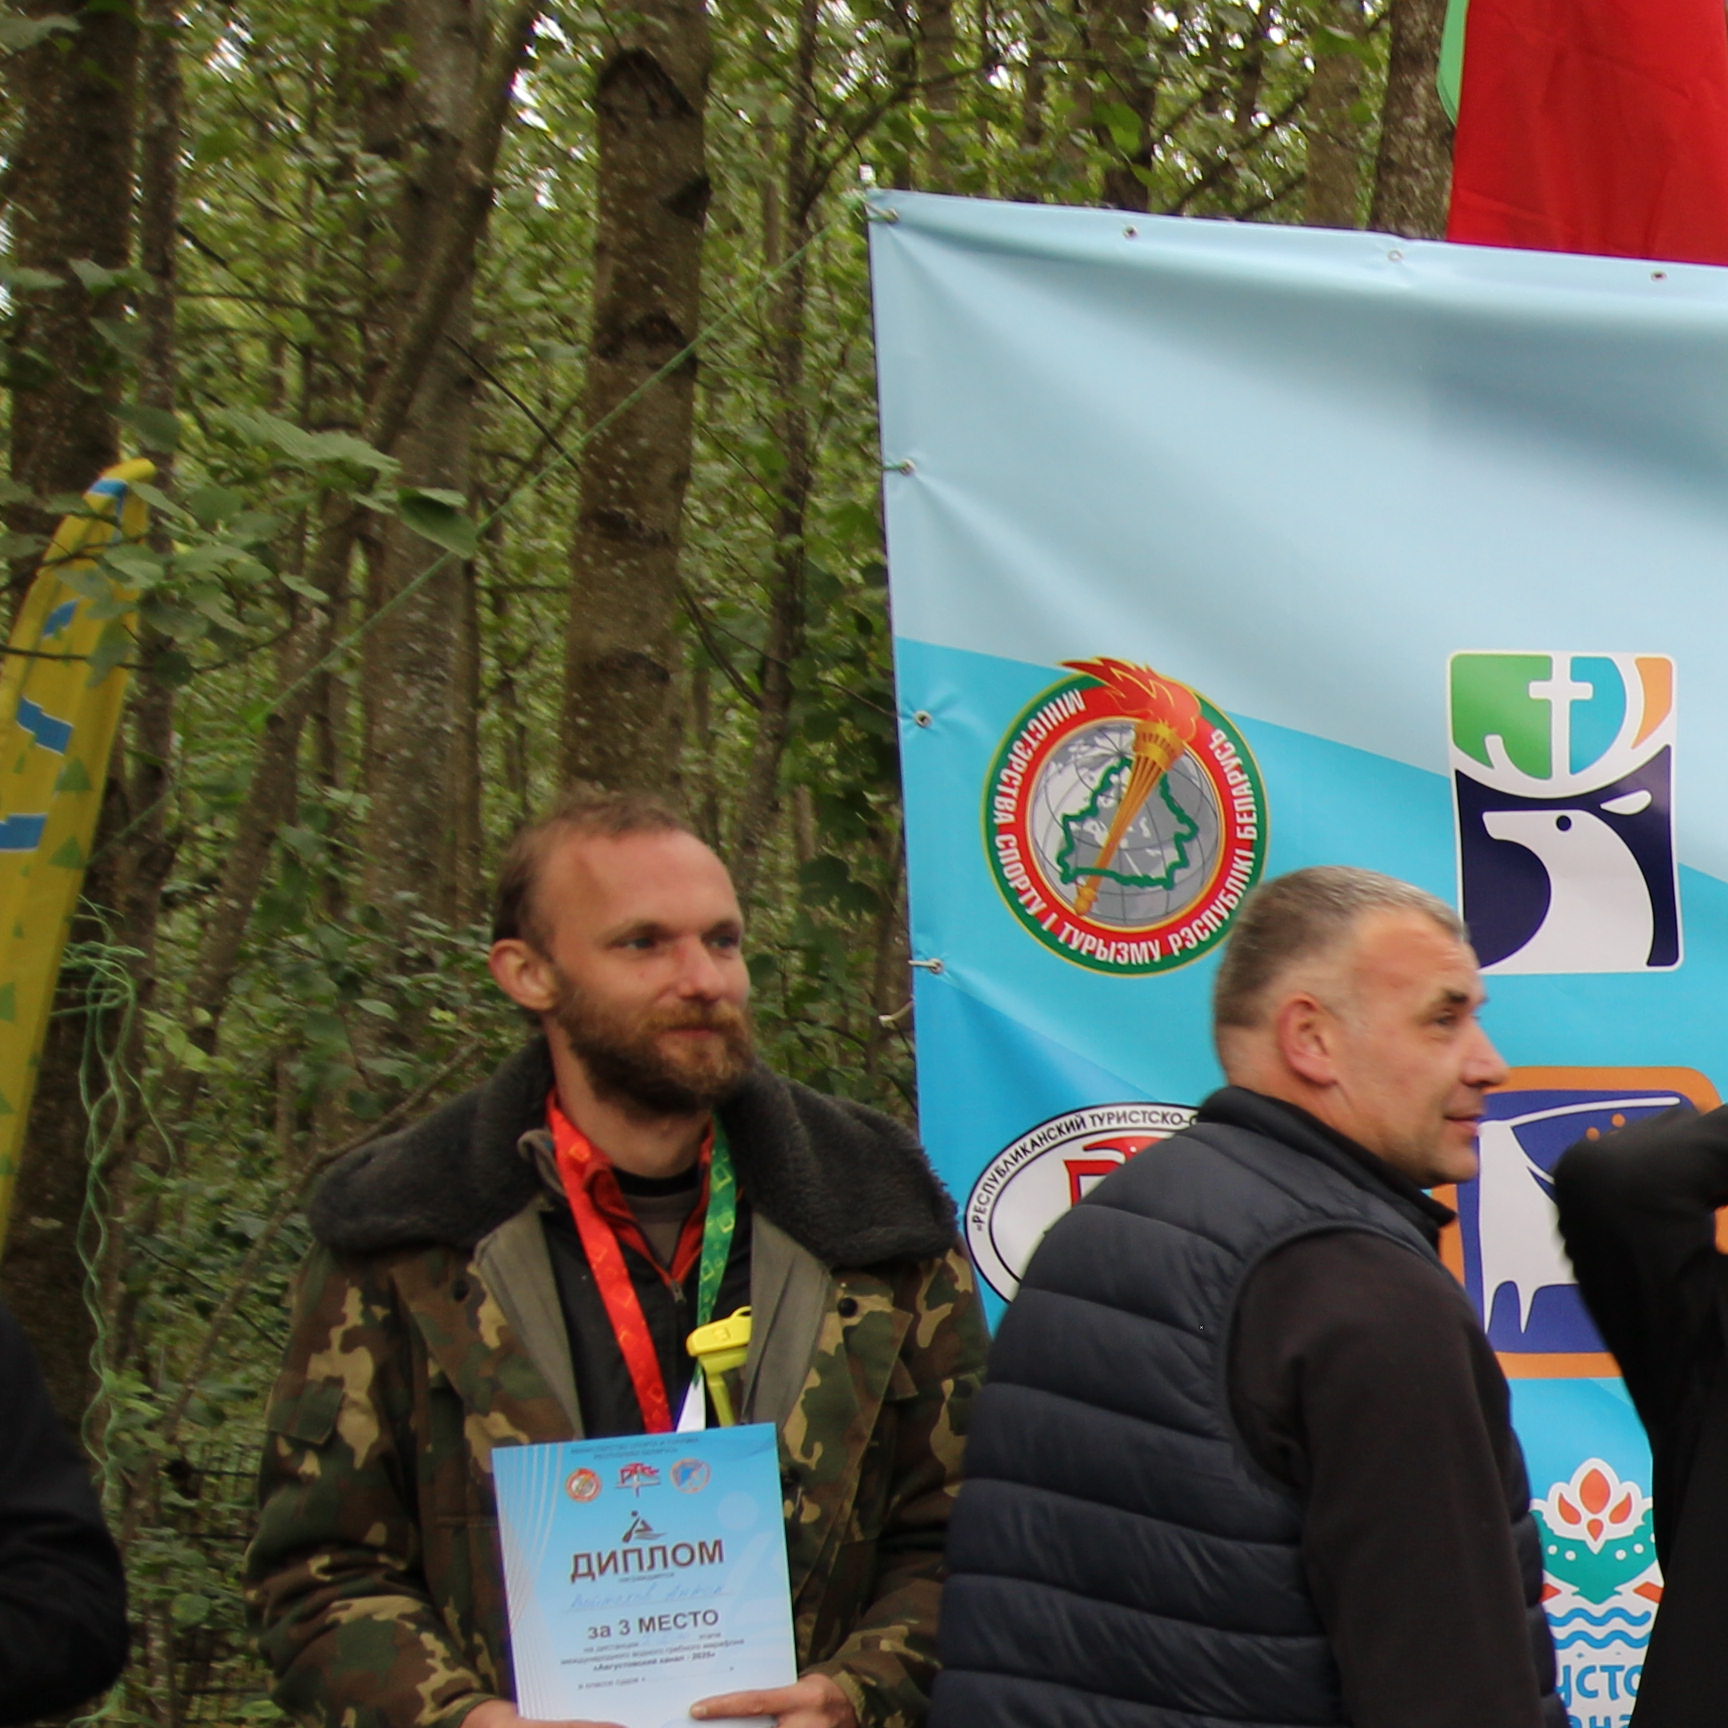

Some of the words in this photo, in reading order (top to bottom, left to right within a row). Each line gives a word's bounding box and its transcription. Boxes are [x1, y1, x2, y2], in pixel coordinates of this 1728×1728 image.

[993, 688, 1087, 824] МІНІСТЭРСТВА
[1208, 728, 1259, 840] БЕЛАРУСЬ
[994, 834, 1048, 917] СПОРТУ
[1168, 847, 1256, 956] РЭСПУБЛІКІ
[1057, 920, 1162, 966] ТУРЫЗМУ
[570, 1538, 725, 1584] ДИПЛОМ
[587, 1624, 612, 1640] за
[618, 1618, 632, 1637] 3
[638, 1608, 720, 1635] МЕСТО
